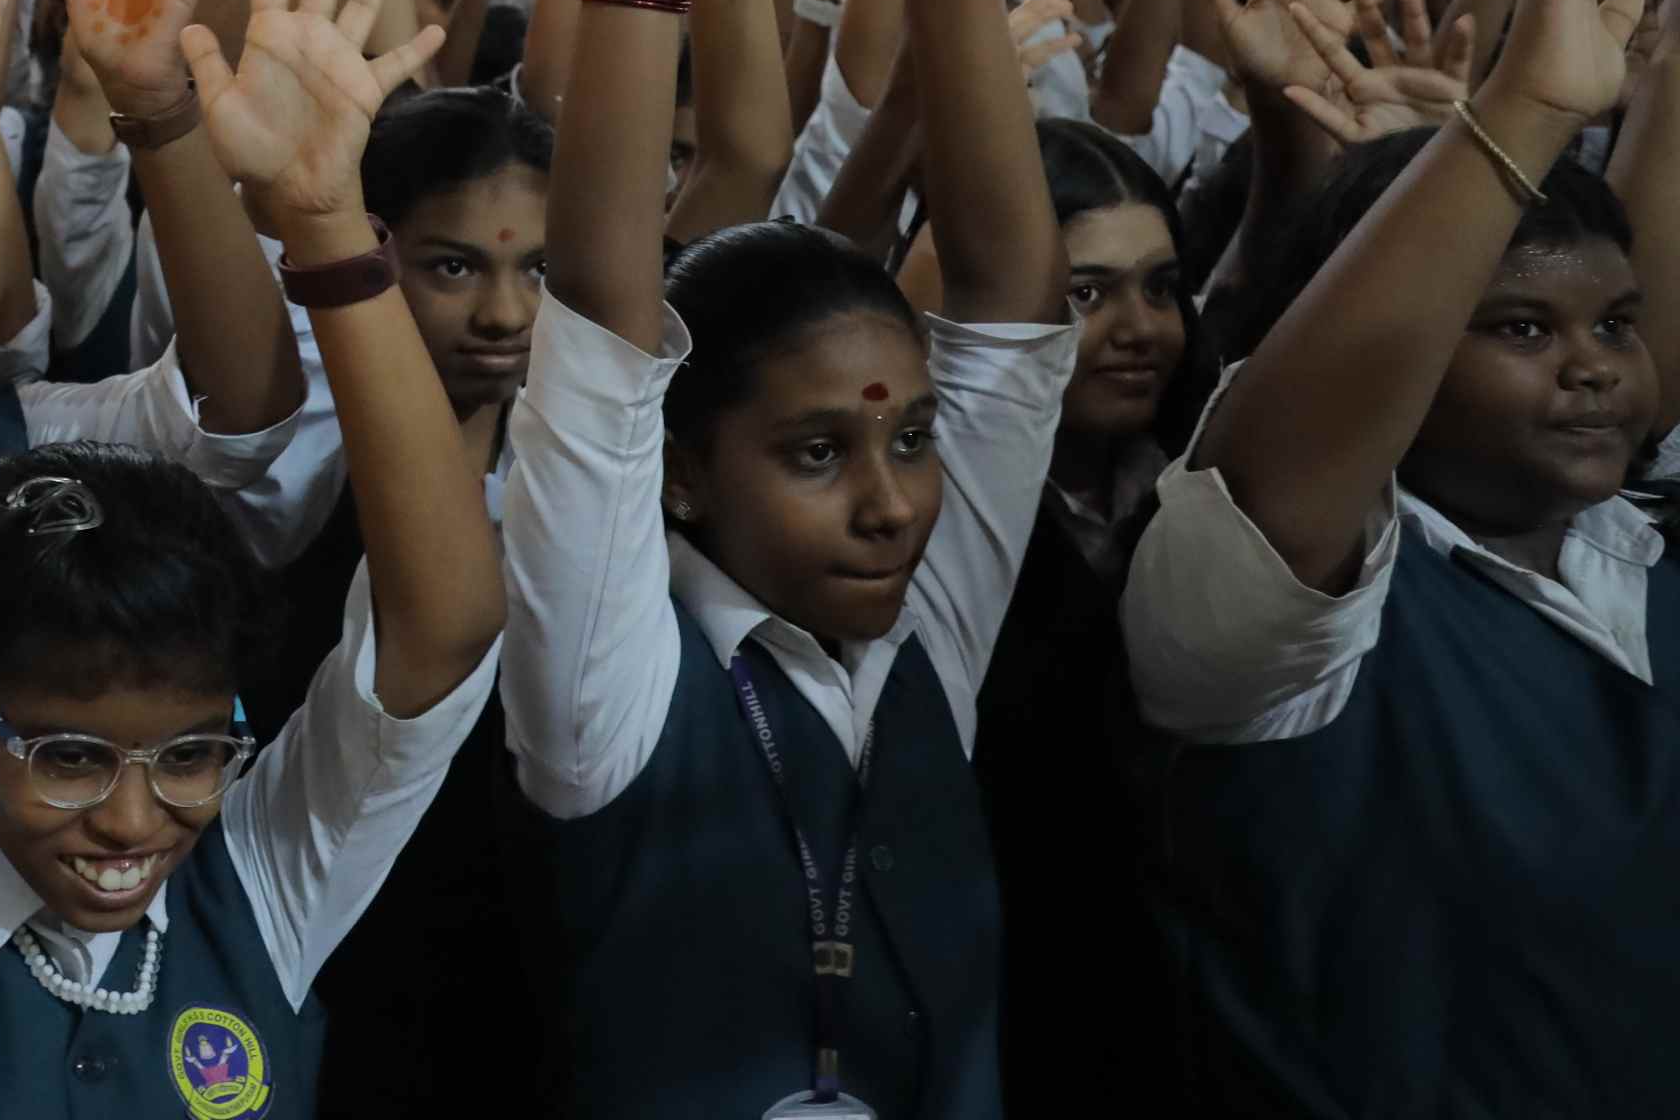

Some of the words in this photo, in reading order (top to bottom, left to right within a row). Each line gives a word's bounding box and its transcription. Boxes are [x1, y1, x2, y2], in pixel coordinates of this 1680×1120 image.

[807, 887, 826, 936] GOVT
[834, 887, 854, 937] GOVT
[206, 1012, 246, 1037] COTTON
